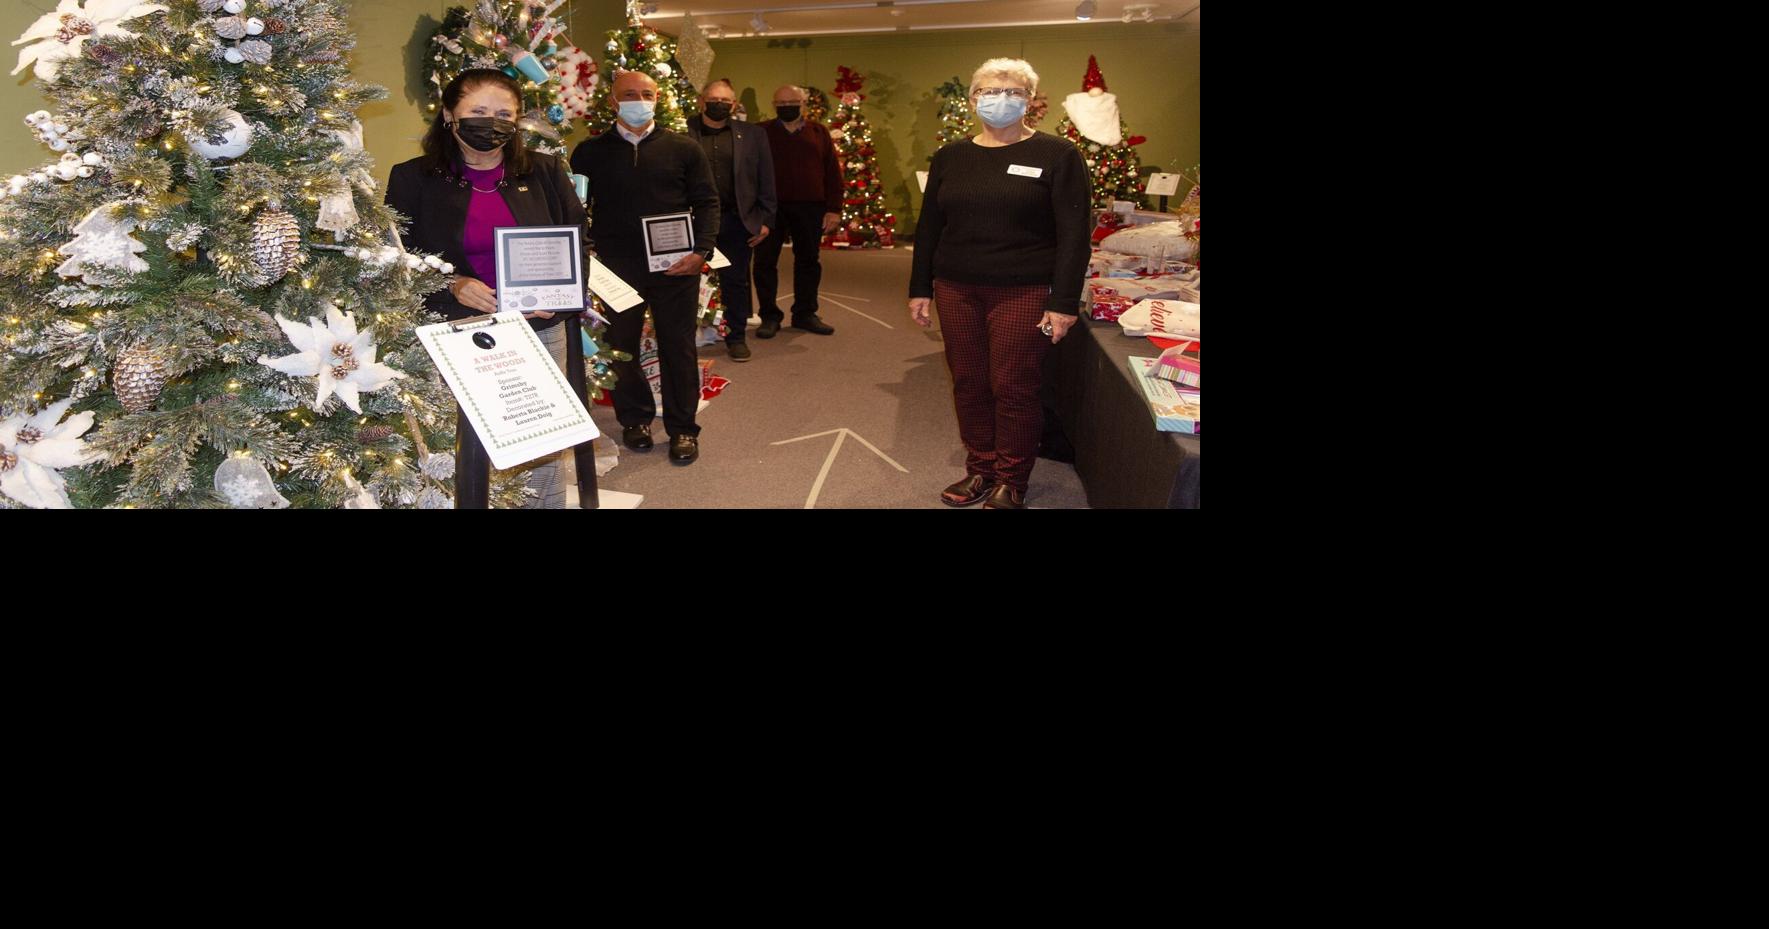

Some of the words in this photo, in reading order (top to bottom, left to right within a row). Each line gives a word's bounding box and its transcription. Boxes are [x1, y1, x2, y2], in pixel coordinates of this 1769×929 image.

[481, 352, 506, 362] WALK
[475, 364, 494, 373] THE
[494, 357, 526, 369] WOODS
[500, 381, 527, 391] Grimsby
[499, 389, 522, 399] Garden
[502, 411, 527, 421] Roberta
[515, 416, 537, 426] Lauren
[537, 411, 553, 420] Doig
